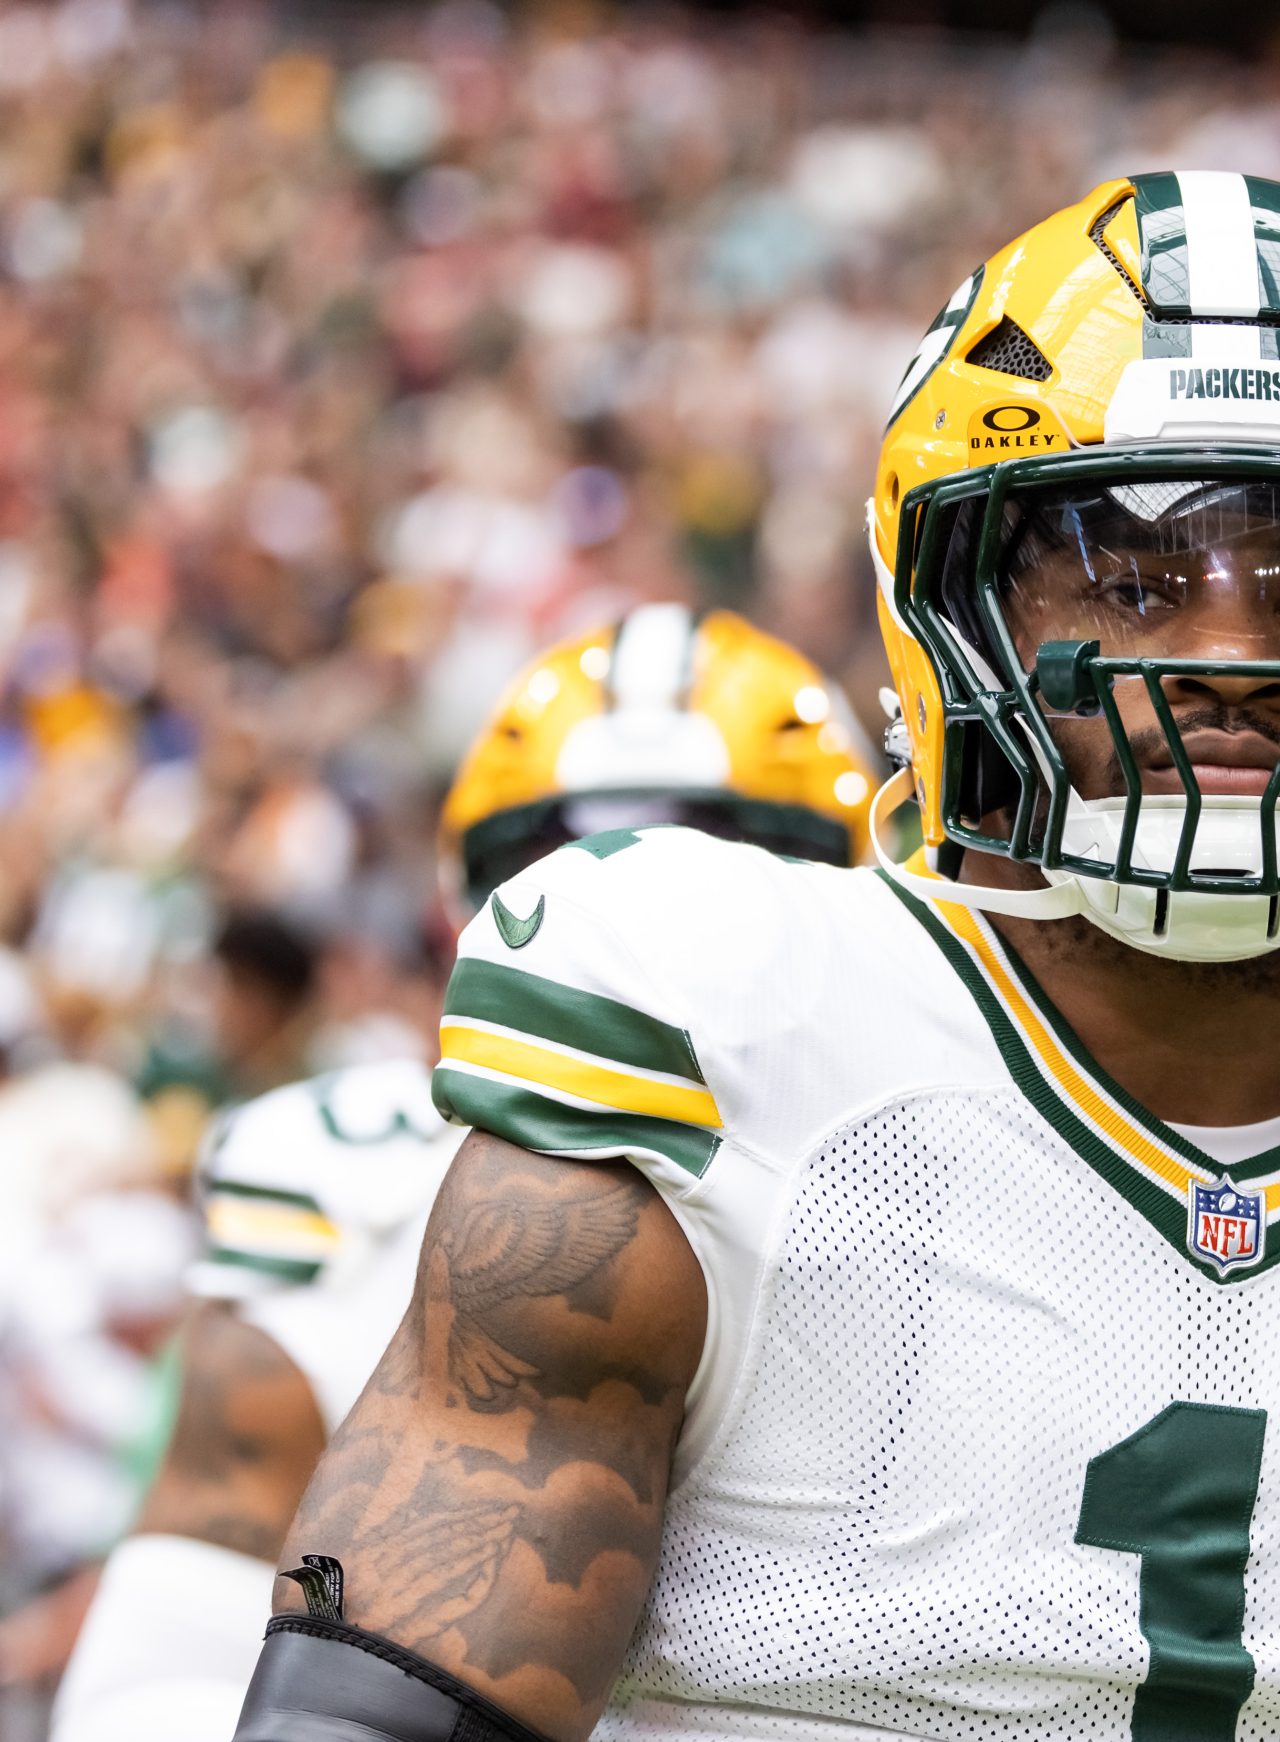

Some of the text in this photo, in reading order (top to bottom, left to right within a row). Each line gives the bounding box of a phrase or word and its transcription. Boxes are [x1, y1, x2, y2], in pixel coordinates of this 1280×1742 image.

[970, 434, 1055, 449] OAKLEY
[1200, 1214, 1253, 1258] NFL
[1074, 1400, 1268, 1742] 1
